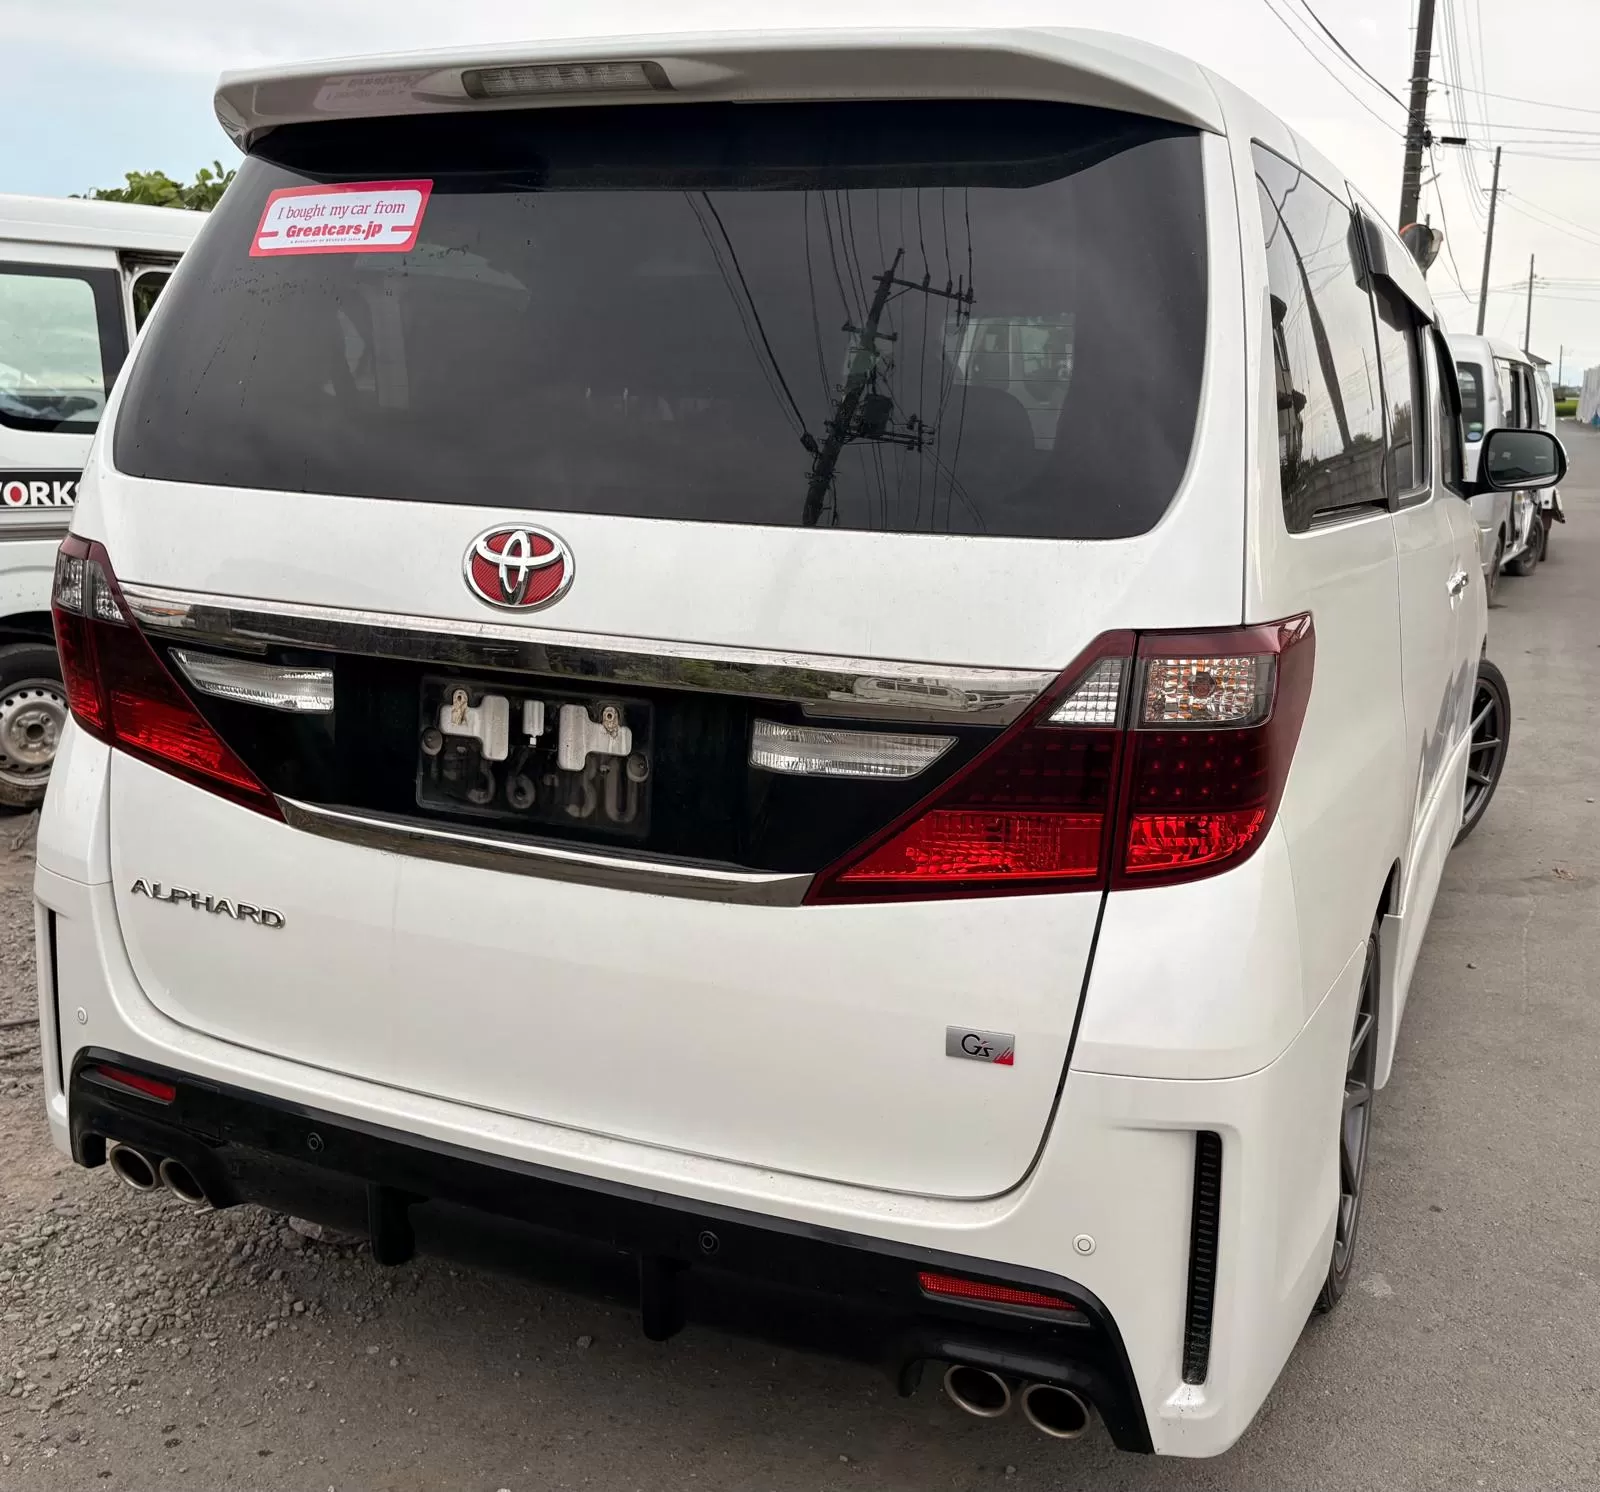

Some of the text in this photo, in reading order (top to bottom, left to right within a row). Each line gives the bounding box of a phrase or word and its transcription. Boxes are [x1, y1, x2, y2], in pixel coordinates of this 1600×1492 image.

[278, 200, 406, 221] I bought my car from
[286, 221, 383, 240] Greatcars.jp
[131, 877, 286, 929] ALPHARD
